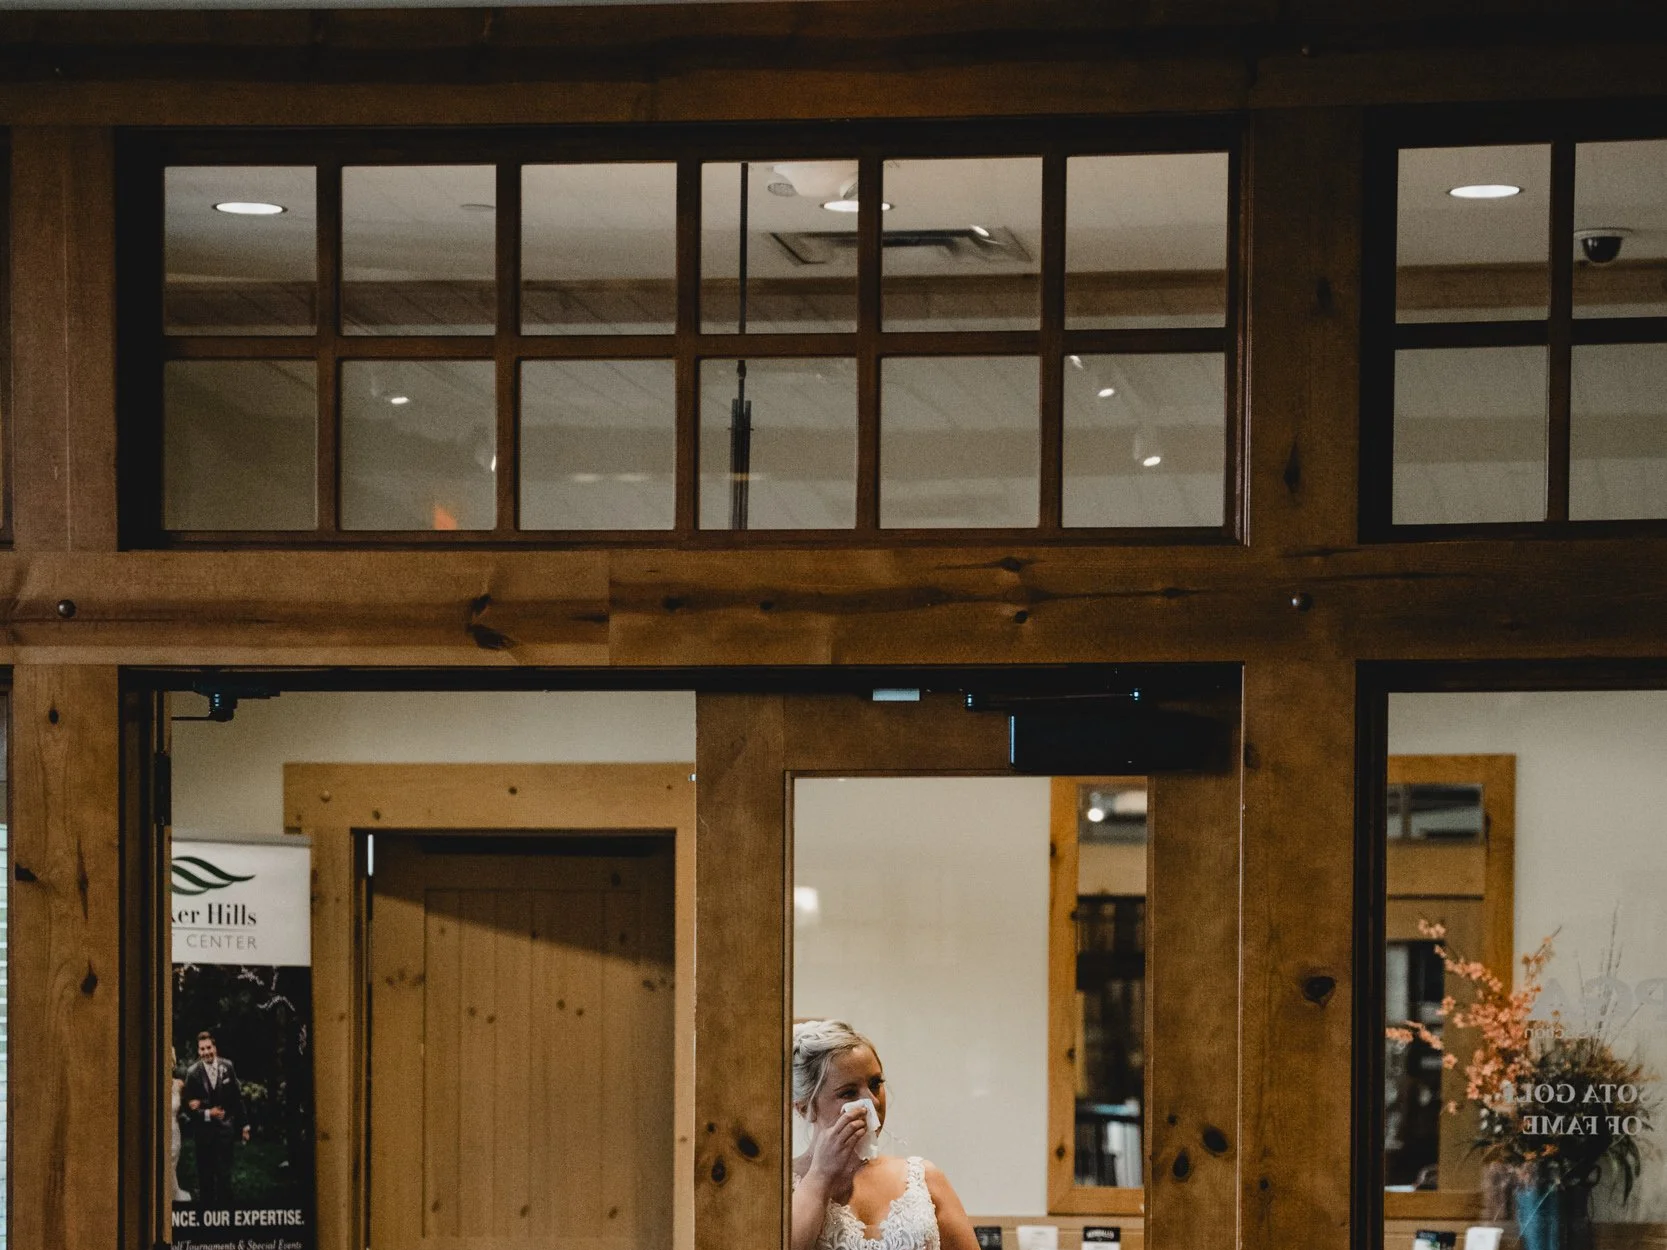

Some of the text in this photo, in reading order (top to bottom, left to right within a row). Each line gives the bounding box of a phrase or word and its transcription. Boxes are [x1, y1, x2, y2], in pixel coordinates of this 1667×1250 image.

[172, 903, 257, 926] er Hills
[186, 934, 257, 950] CENTER
[171, 1208, 305, 1227] NCE. OUR EXPERTISE.
[277, 1239, 302, 1250] Events
